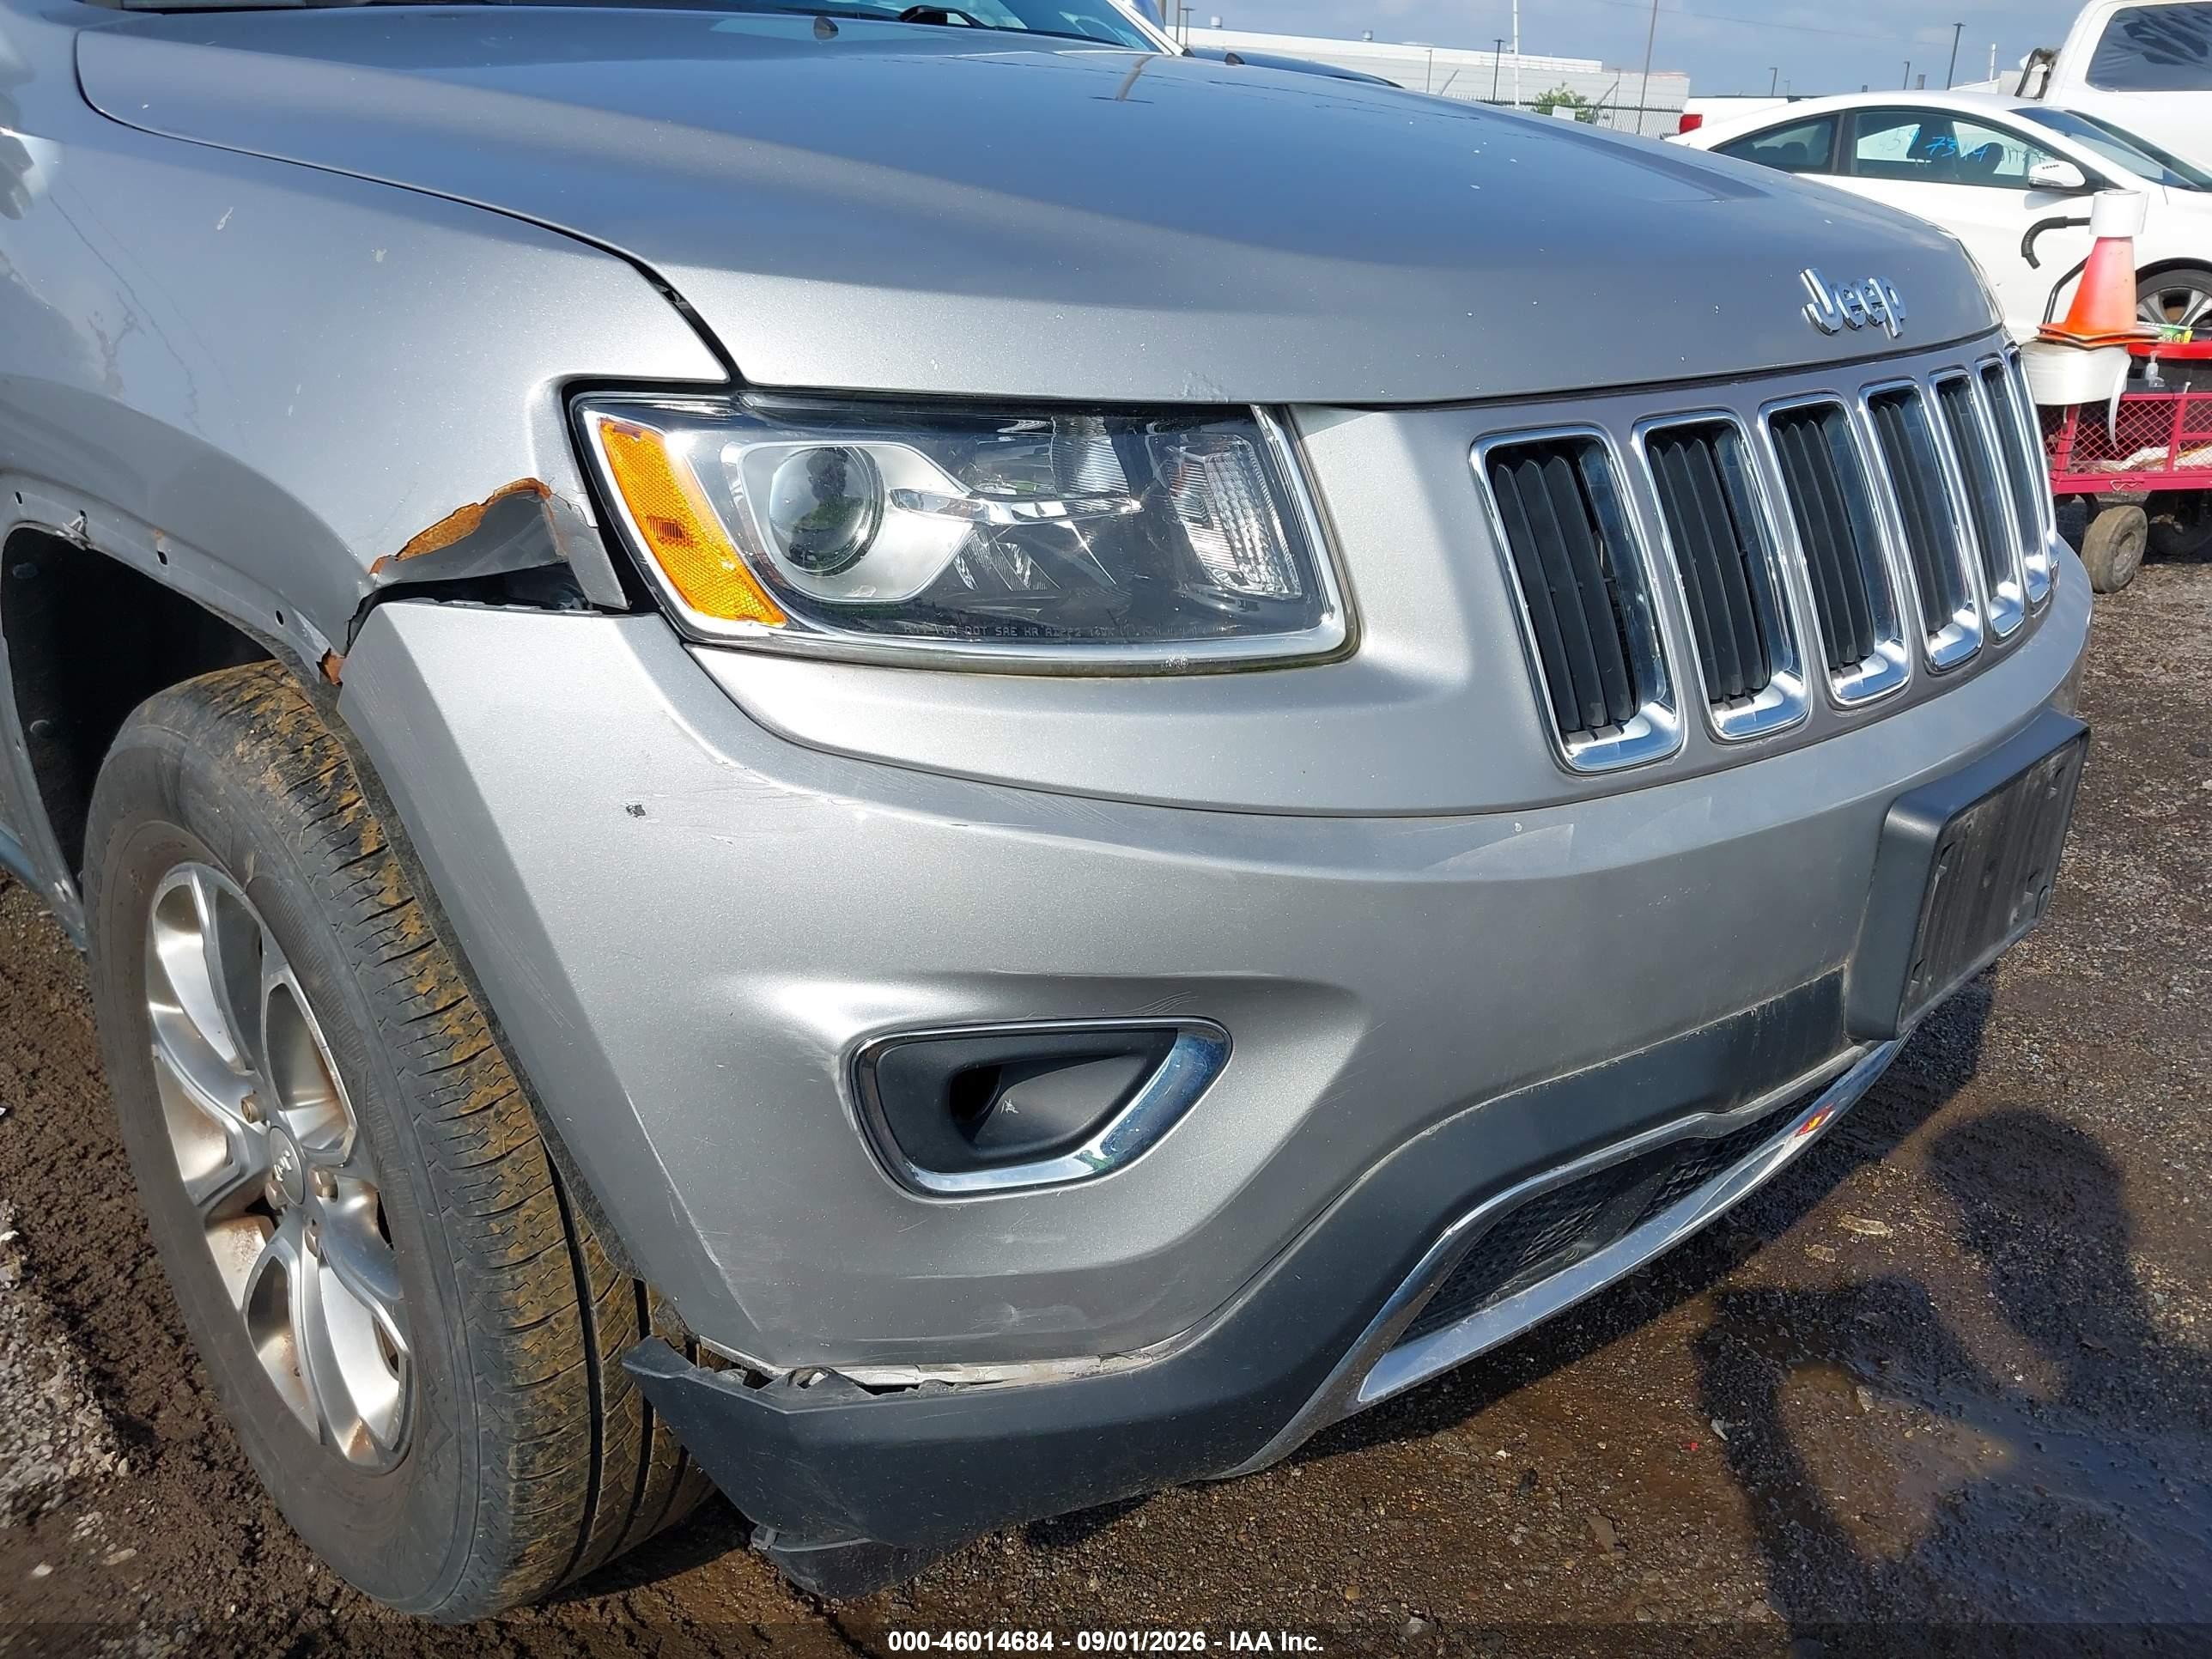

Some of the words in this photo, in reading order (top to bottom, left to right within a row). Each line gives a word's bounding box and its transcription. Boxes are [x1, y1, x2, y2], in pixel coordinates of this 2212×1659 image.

[1800, 267, 1907, 338] Jeep
[964, 625, 988, 636] DOT
[994, 626, 1018, 637] SAE
[1024, 626, 1040, 637] HR
